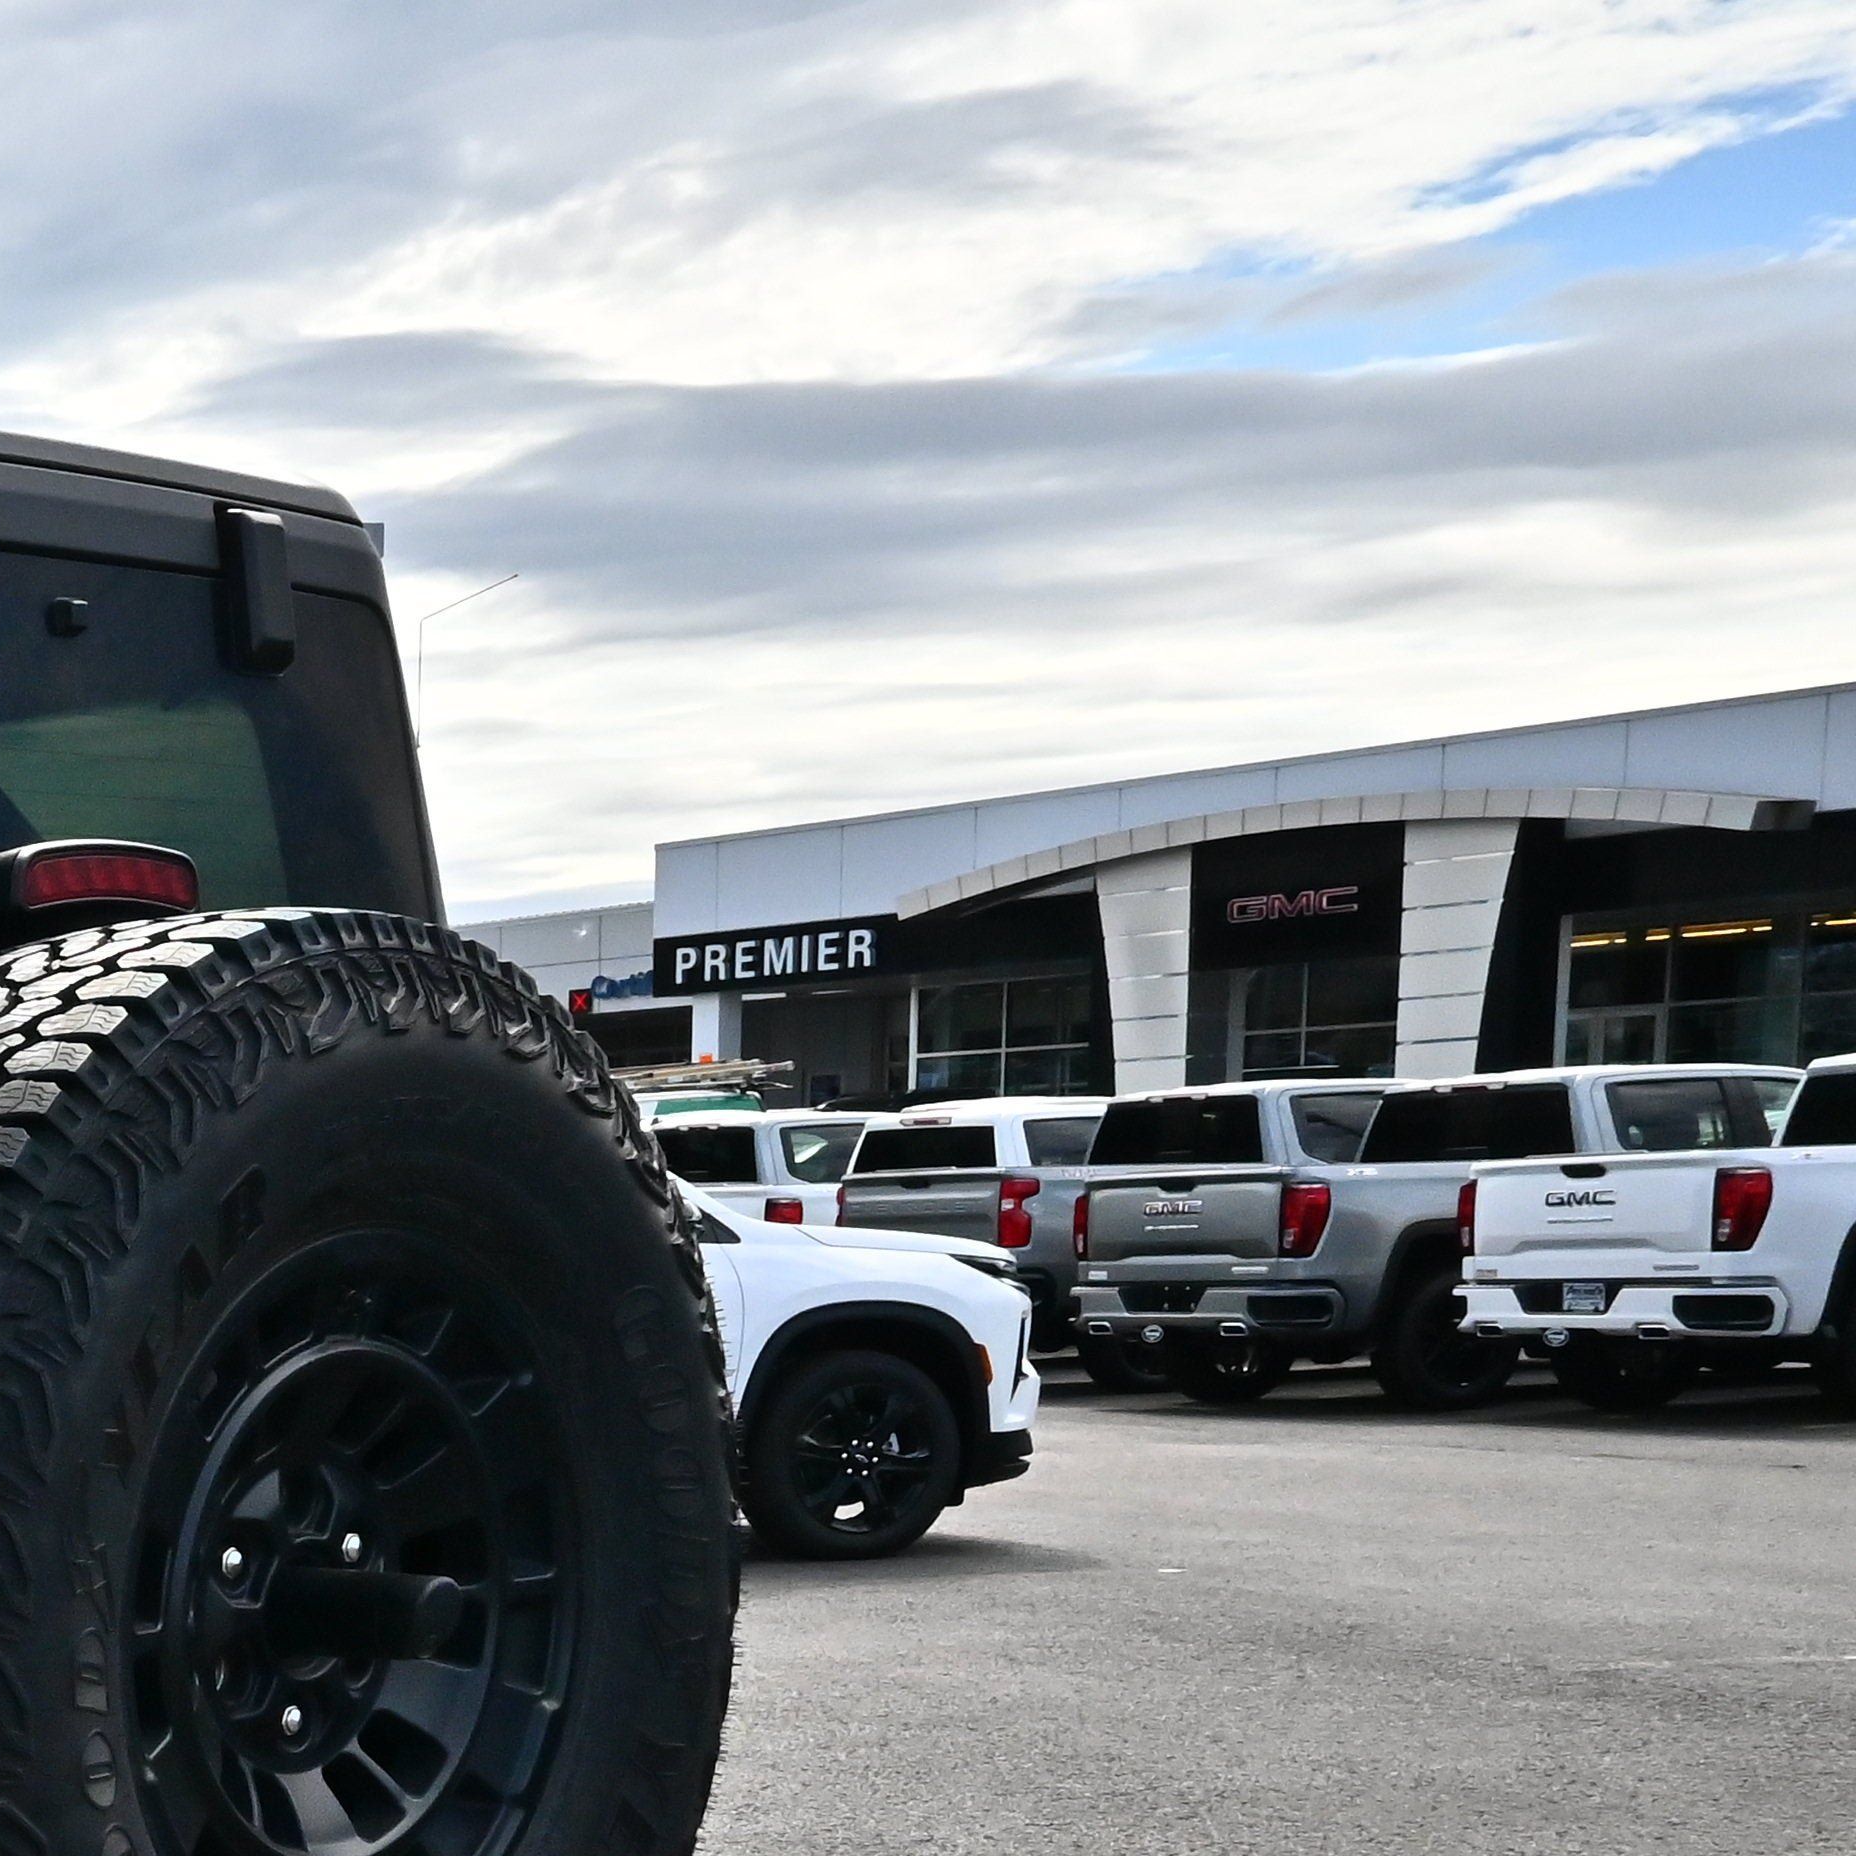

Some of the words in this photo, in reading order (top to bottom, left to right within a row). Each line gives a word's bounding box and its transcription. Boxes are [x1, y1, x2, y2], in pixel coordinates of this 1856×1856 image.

[1227, 886, 1359, 923] GMC
[675, 929, 875, 985] PREMIER
[1143, 1200, 1203, 1218] GMC
[1544, 1190, 1616, 1208] GMC
